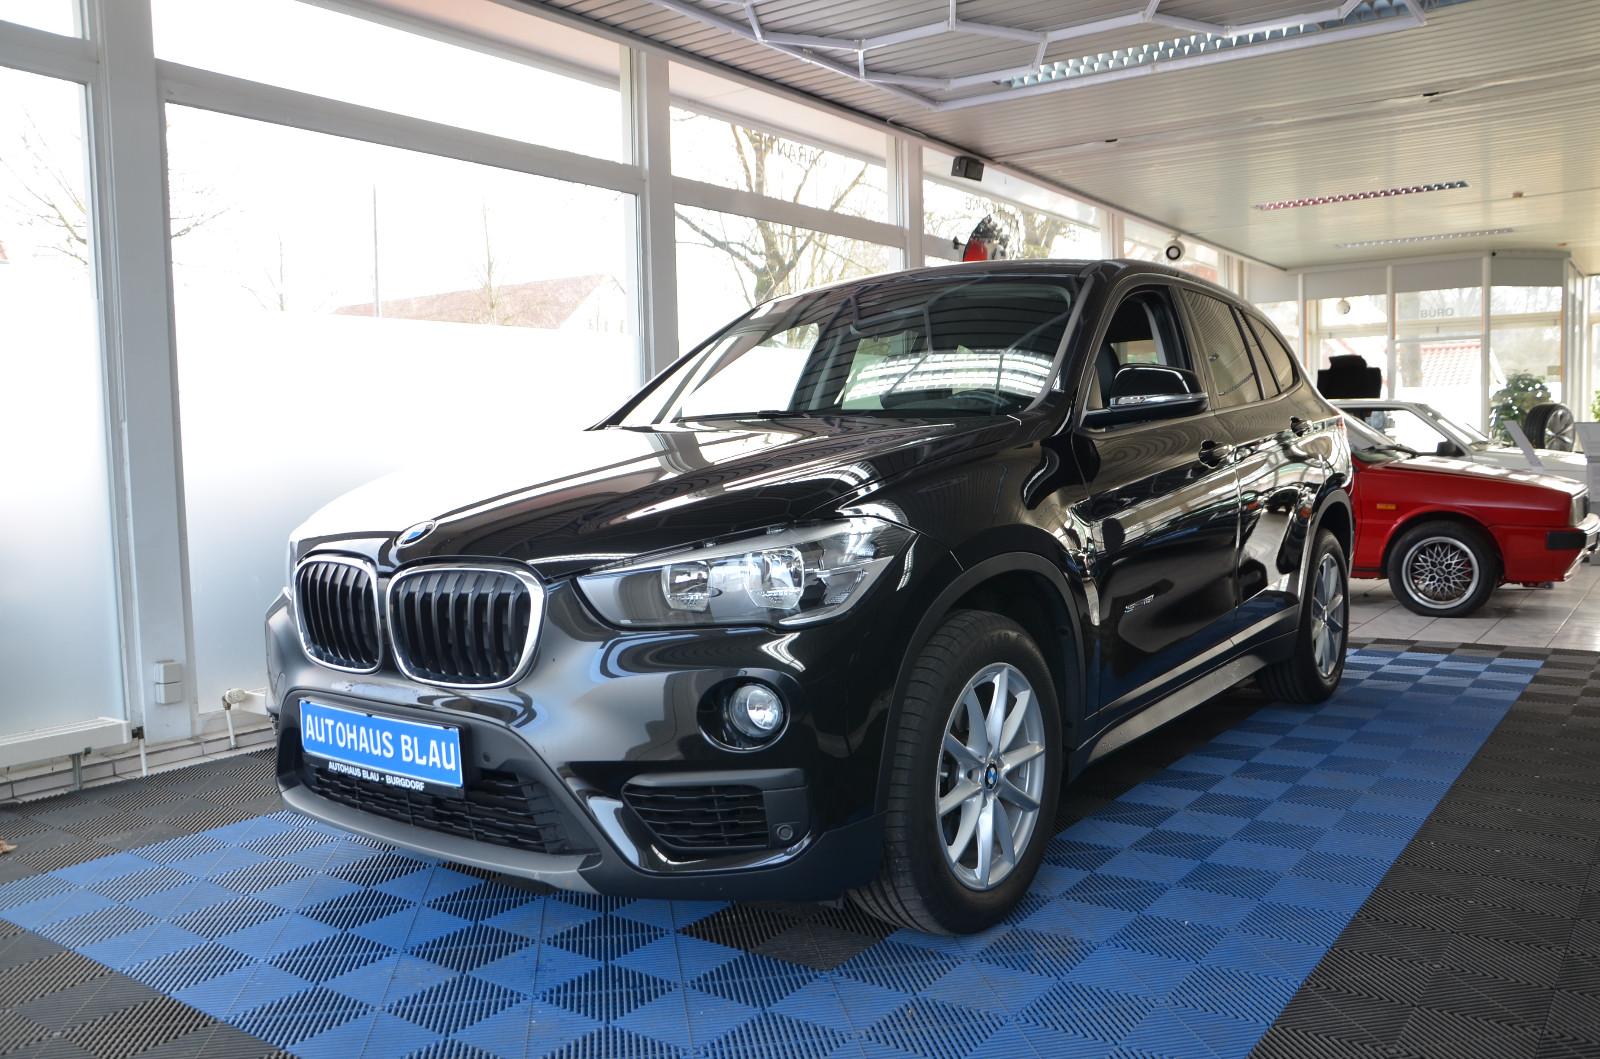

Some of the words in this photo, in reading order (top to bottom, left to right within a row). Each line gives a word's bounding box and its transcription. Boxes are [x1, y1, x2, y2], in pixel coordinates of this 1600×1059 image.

[305, 714, 395, 758] AUTOHAUS
[400, 734, 456, 771] BLAU
[328, 761, 362, 777] AUTOHAUS
[362, 768, 380, 782] BLAU
[385, 775, 425, 791] BURGDORF
